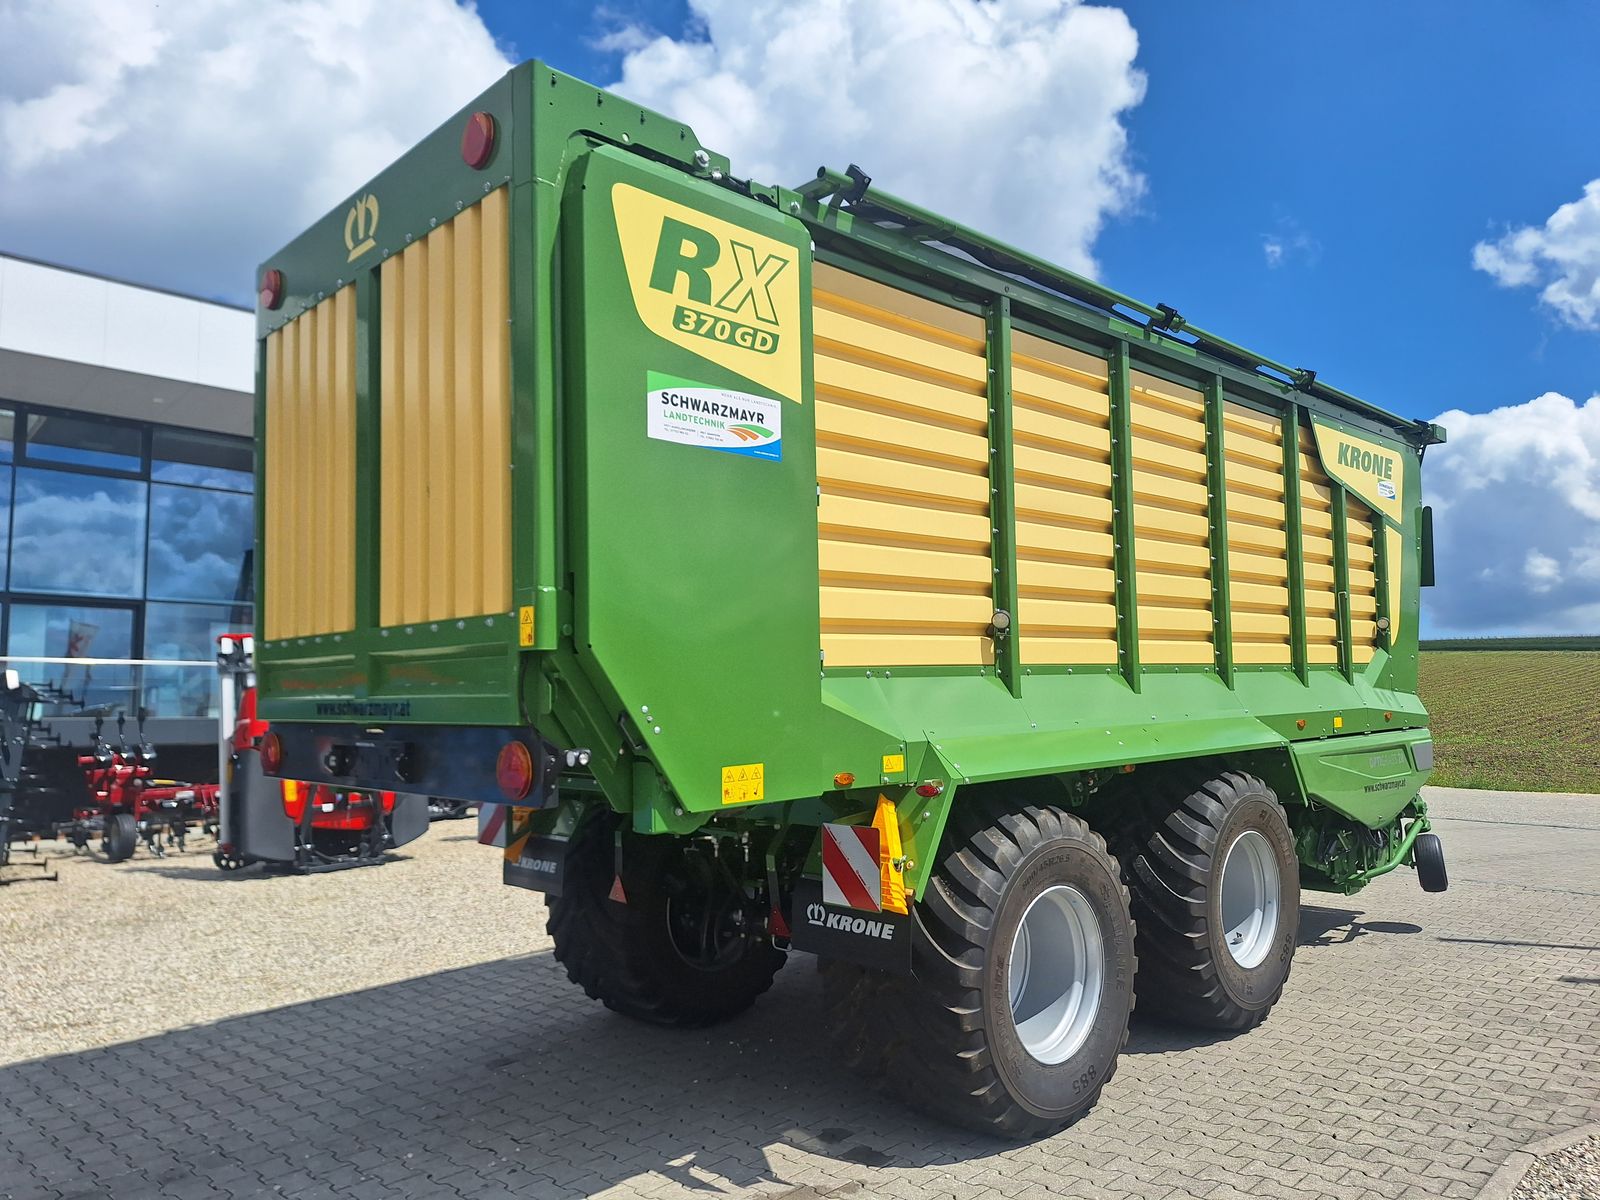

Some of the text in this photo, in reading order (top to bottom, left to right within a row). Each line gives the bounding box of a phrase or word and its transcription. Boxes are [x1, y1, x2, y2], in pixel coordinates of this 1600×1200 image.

[649, 216, 790, 326] RX
[679, 310, 773, 351] 370 GD
[661, 391, 764, 424] SCHWARZMAYR
[663, 409, 725, 429] LANDTECHNIK
[1338, 442, 1393, 480] KRONE
[520, 856, 557, 874] KRONE
[826, 913, 895, 940] KRONE
[1072, 1064, 1097, 1095] 885
